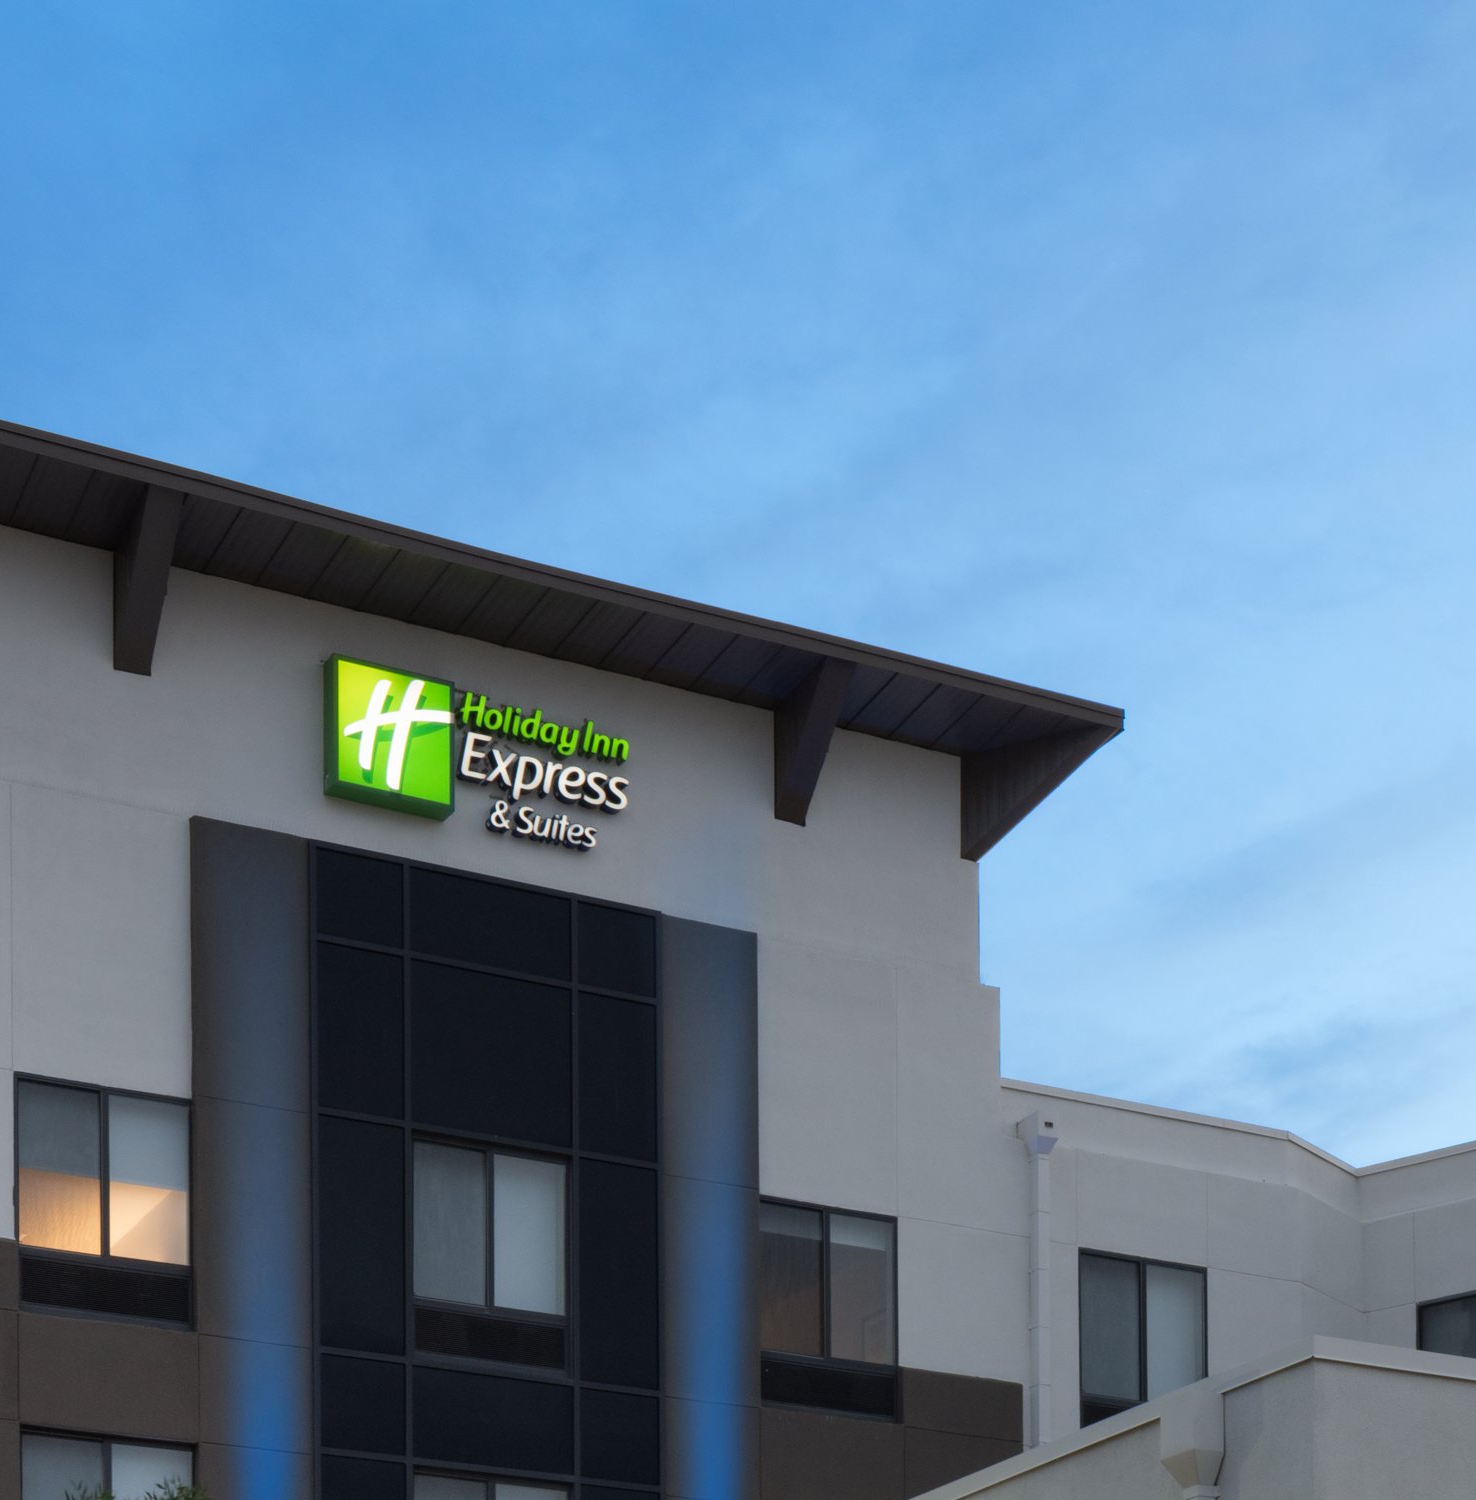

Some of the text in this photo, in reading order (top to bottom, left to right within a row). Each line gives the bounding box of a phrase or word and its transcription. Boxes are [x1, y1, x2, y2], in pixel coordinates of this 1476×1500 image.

[461, 692, 629, 761] Holiday Inn
[460, 731, 629, 811] Express
[490, 799, 597, 848] & Suites
